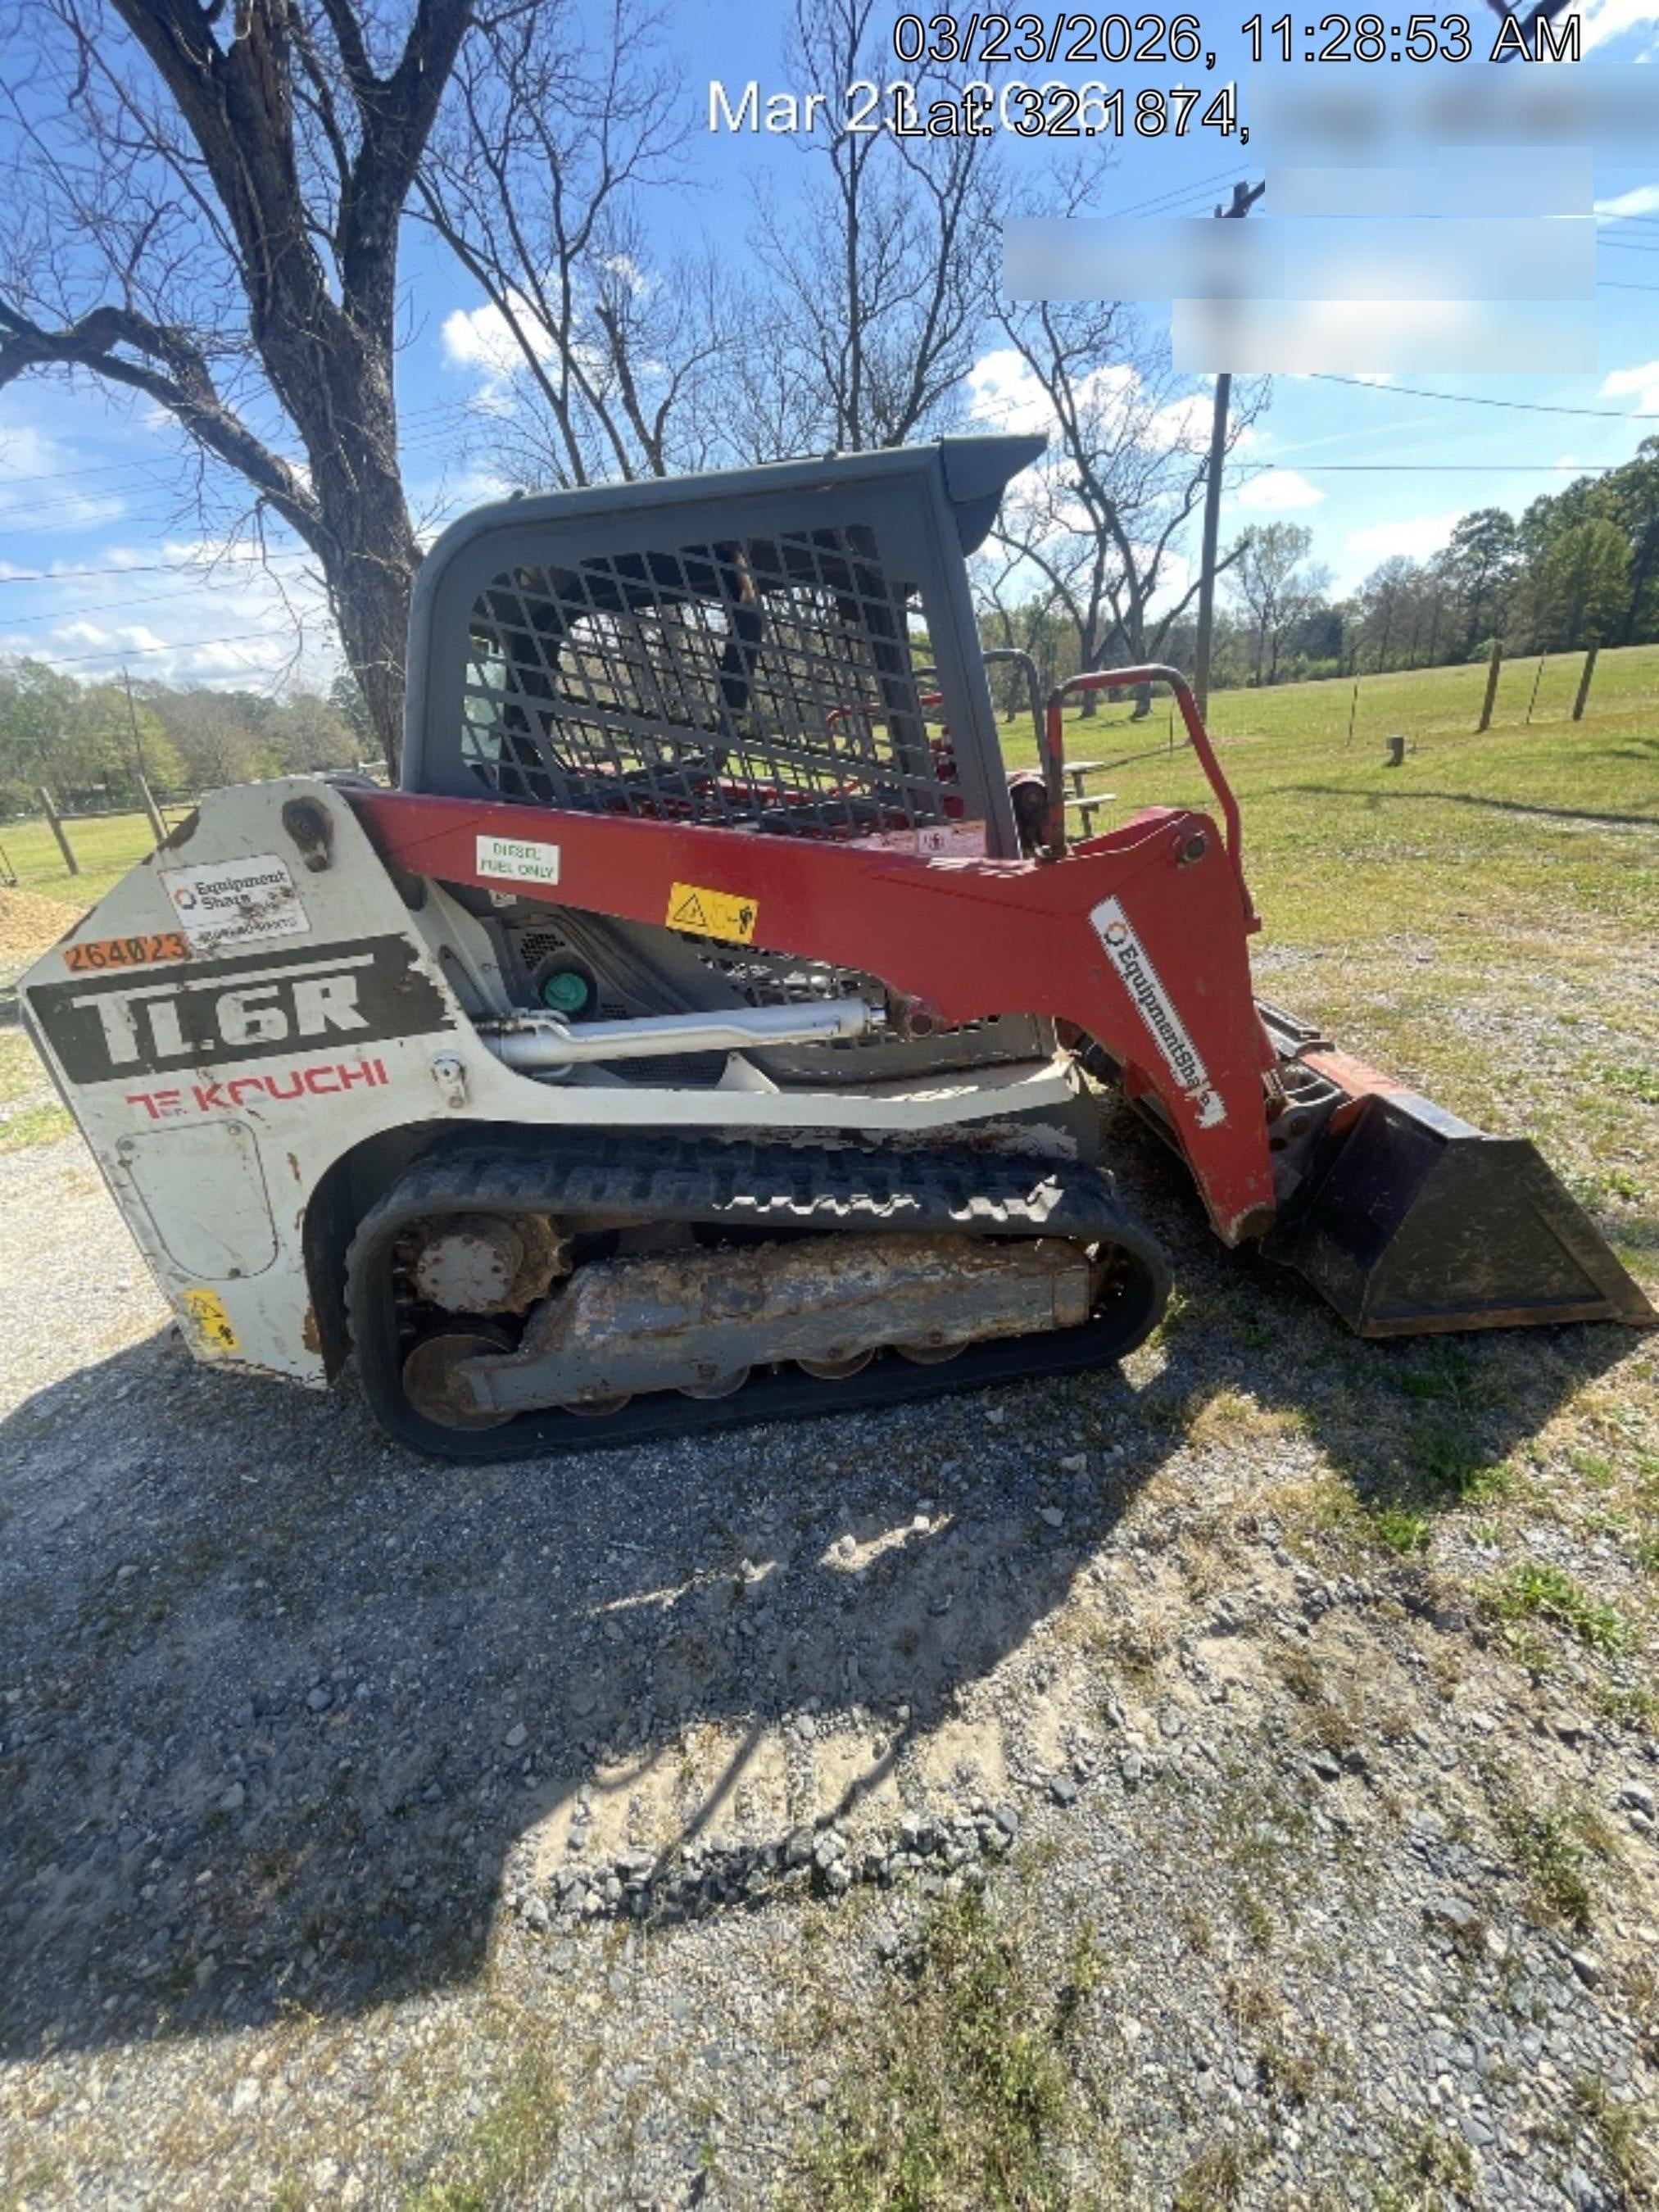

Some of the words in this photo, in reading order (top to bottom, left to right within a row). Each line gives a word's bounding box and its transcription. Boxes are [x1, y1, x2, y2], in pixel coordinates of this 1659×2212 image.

[492, 842, 542, 861] DIESEL
[195, 869, 287, 897] Equipment
[480, 859, 514, 874] FUEL
[517, 864, 554, 879] ONLY
[65, 933, 193, 972] 264023
[71, 953, 375, 1065] TL6R
